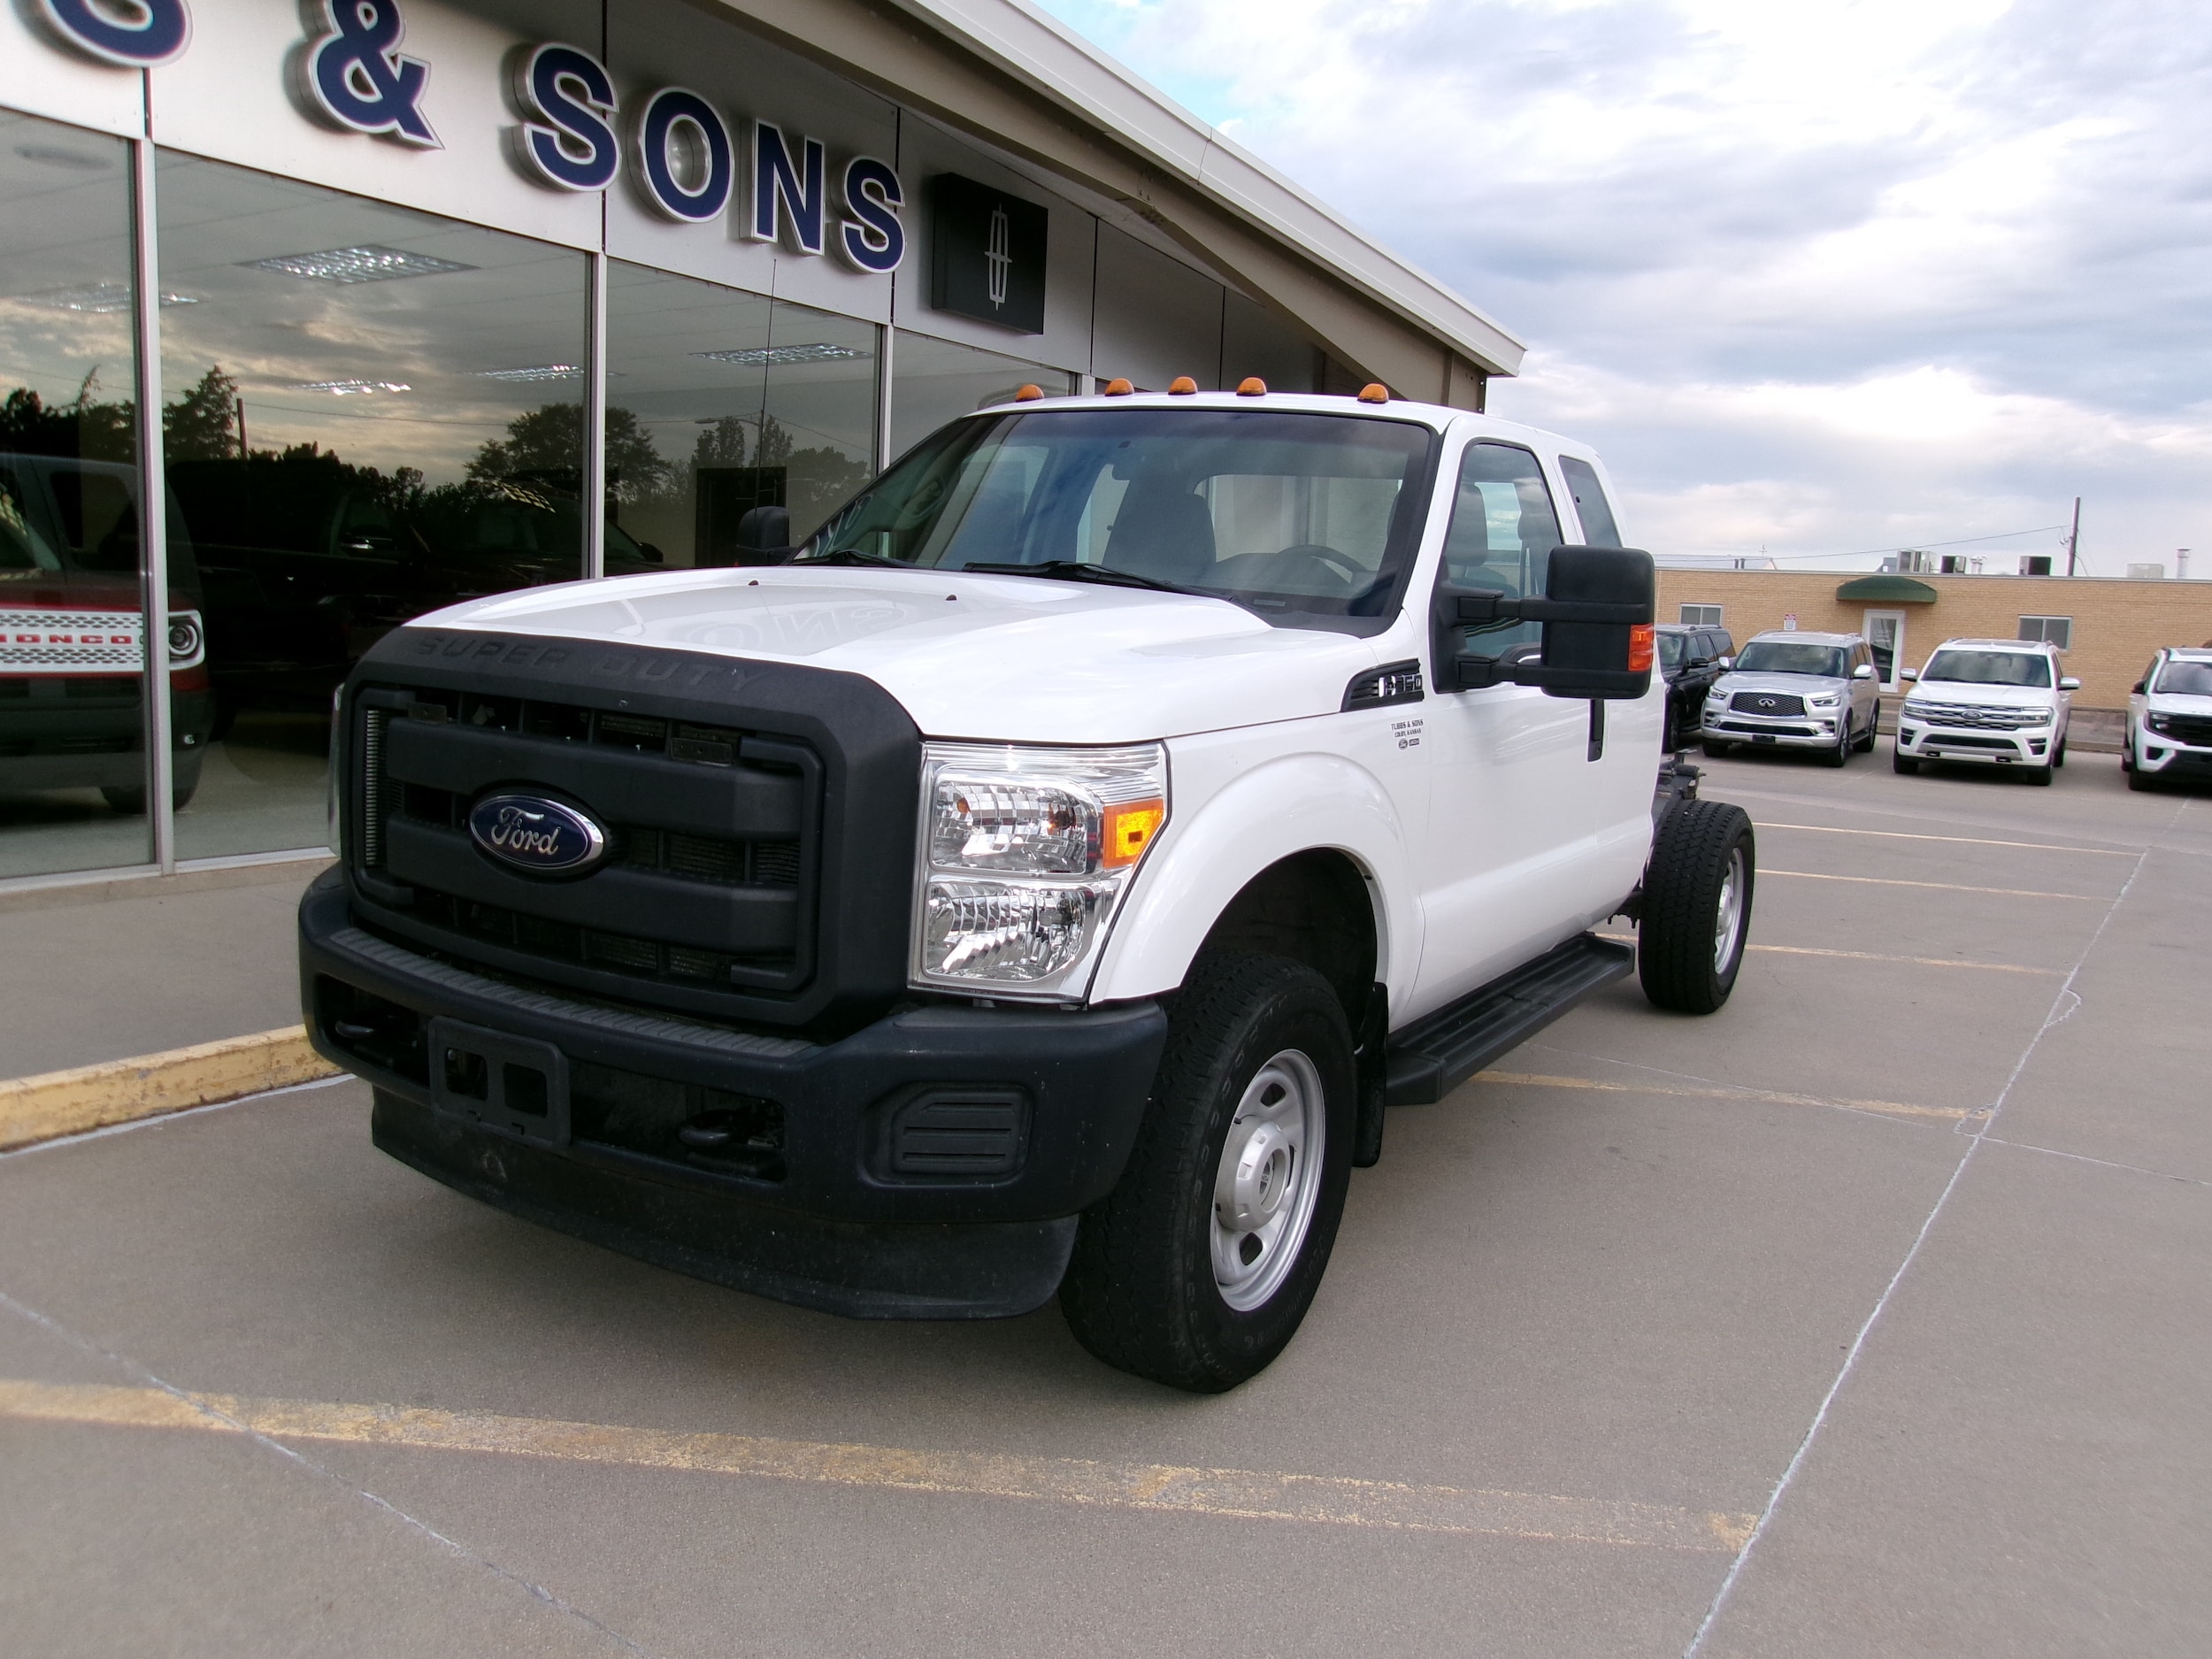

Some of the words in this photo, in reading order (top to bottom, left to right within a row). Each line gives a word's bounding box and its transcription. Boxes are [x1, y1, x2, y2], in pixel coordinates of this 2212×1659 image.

[521, 41, 908, 275] SONS
[0, 634, 132, 644] ONCO
[416, 635, 574, 670] SUPER
[588, 652, 774, 694] DUTY
[491, 805, 562, 856] Ford
